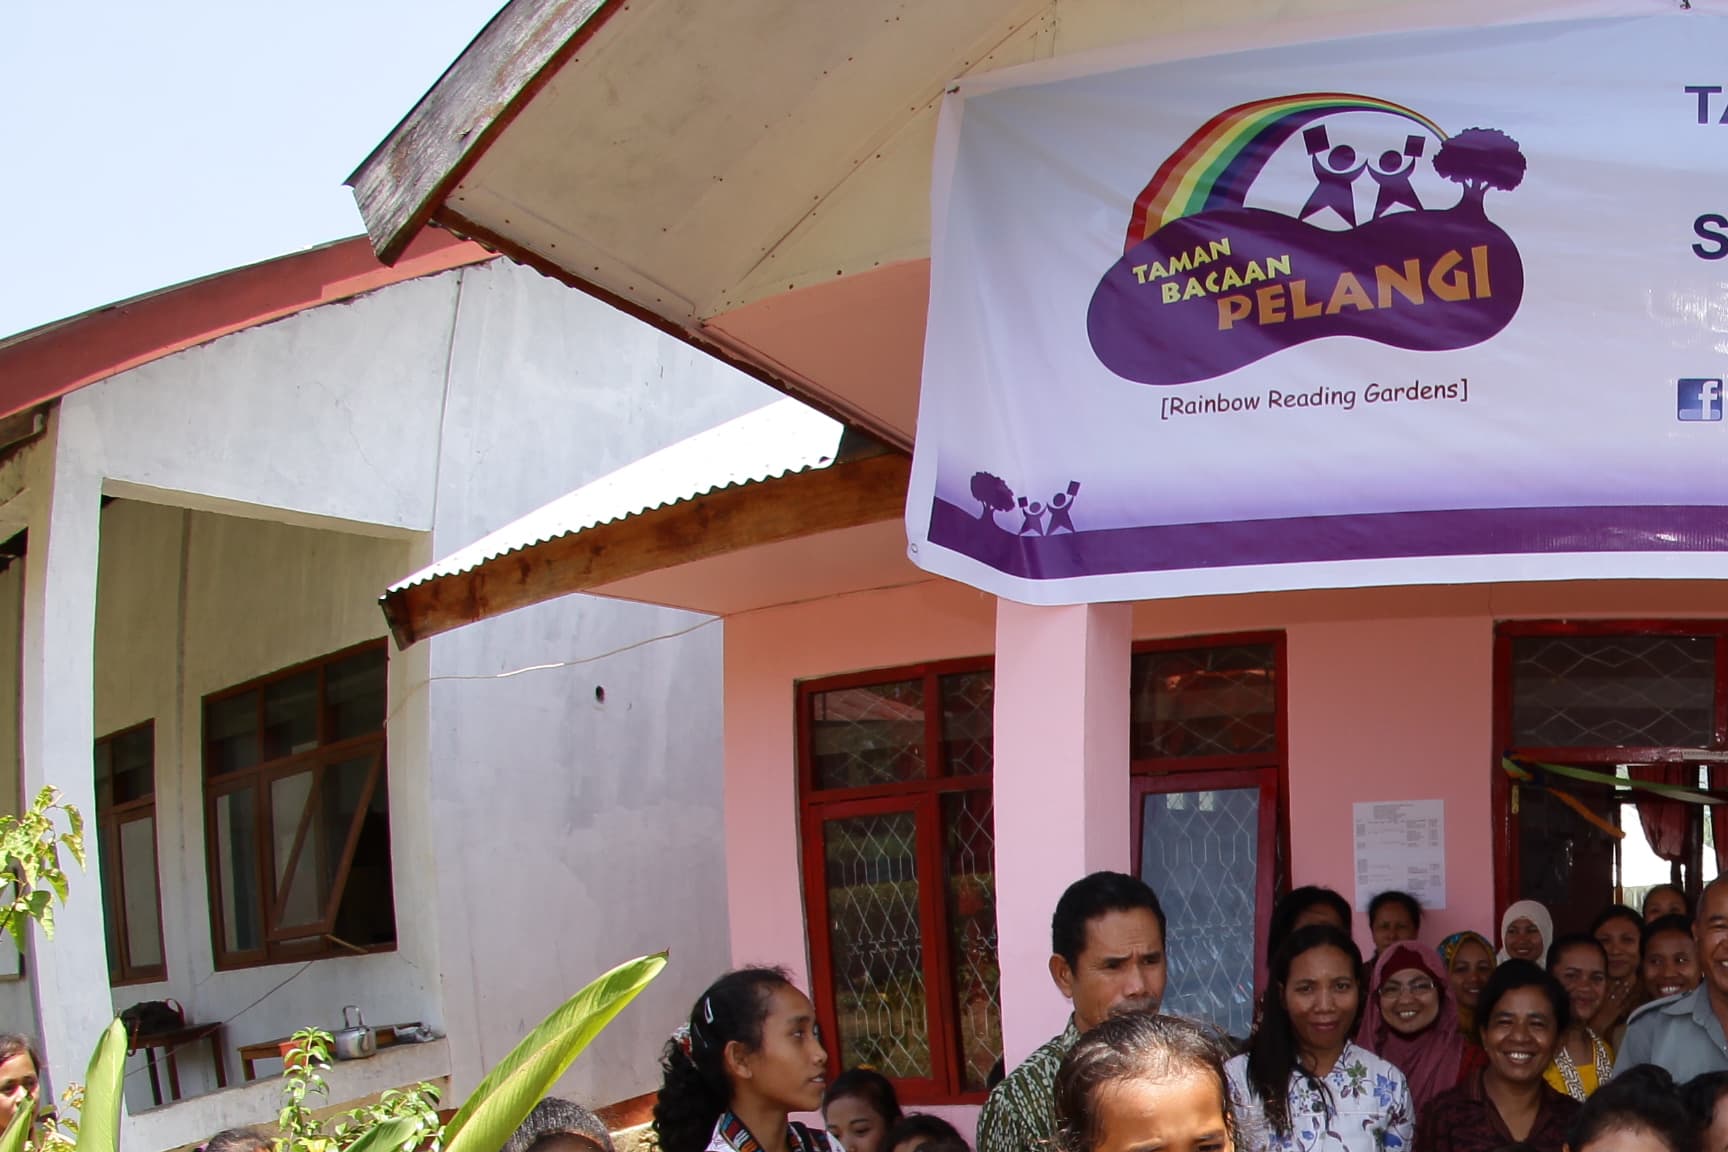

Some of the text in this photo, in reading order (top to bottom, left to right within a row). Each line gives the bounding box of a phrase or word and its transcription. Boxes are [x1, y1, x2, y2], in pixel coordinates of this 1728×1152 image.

[1132, 237, 1231, 284] TAMAN
[1161, 255, 1291, 305] BACAAN
[1216, 244, 1492, 331] PELANGI
[1160, 378, 1469, 420] [Rainbow Reading Gardens]
